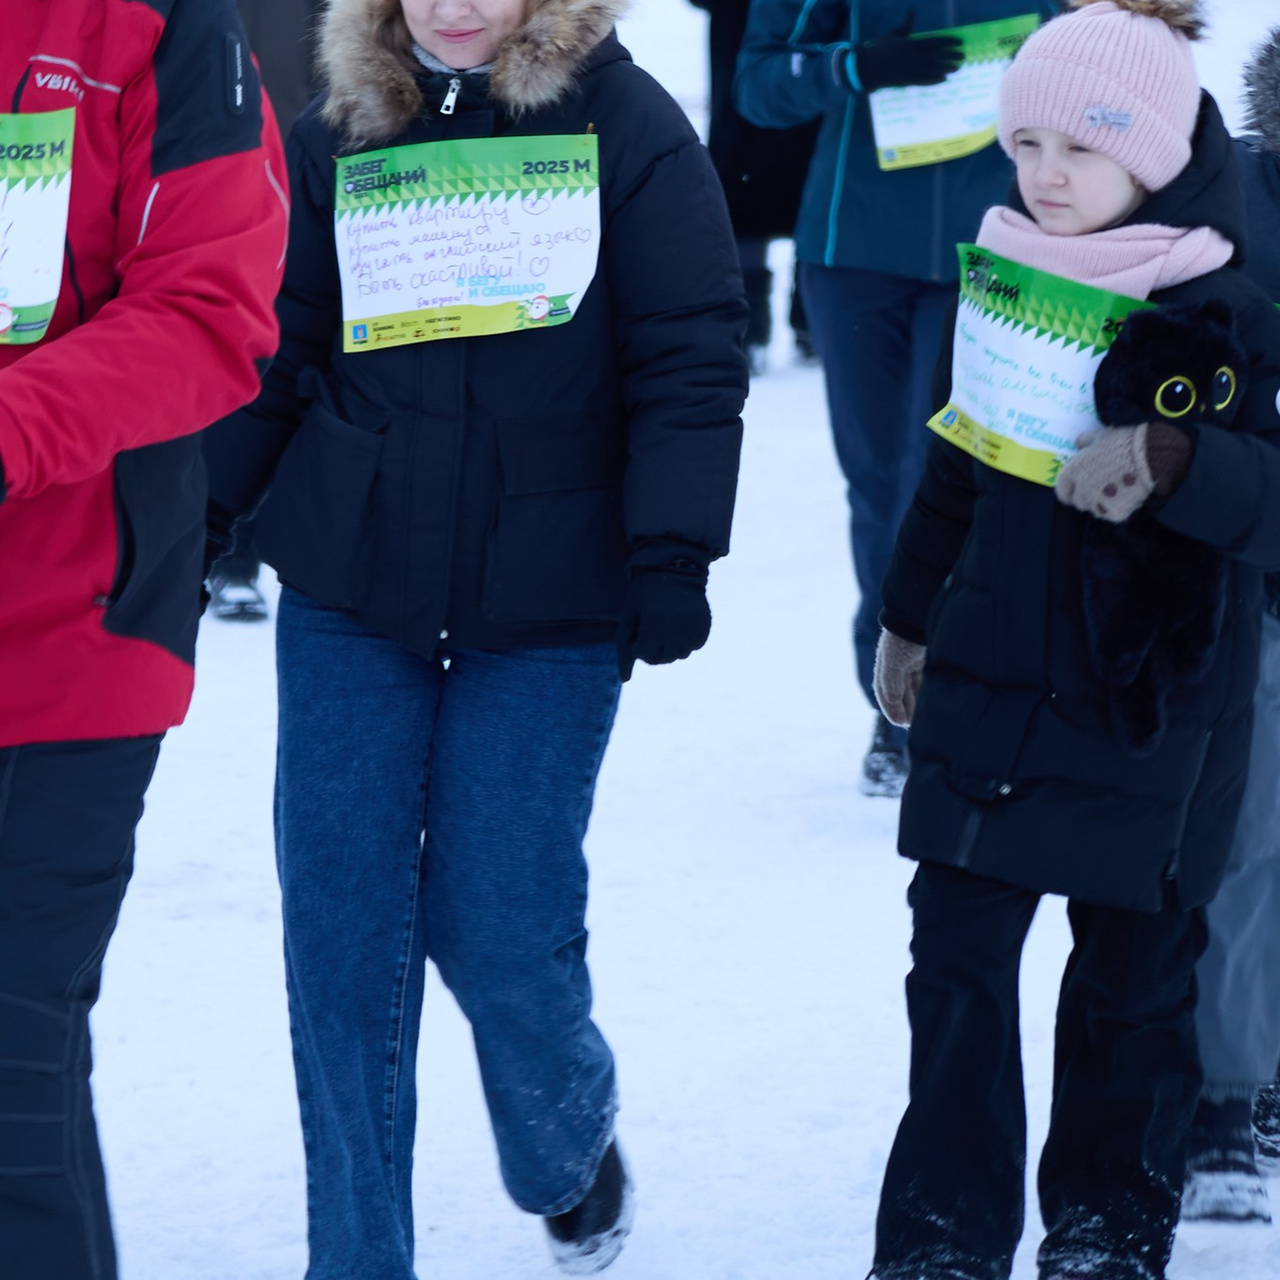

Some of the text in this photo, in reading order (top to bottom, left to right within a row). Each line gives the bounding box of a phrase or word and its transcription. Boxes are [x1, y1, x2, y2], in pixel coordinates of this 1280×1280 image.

[344, 158, 387, 180] ЗАБЕГ
[344, 163, 426, 194] ОБЕЩАНИЙ
[522, 160, 570, 175] 2025
[482, 282, 547, 298] ОБЕЩАЮ
